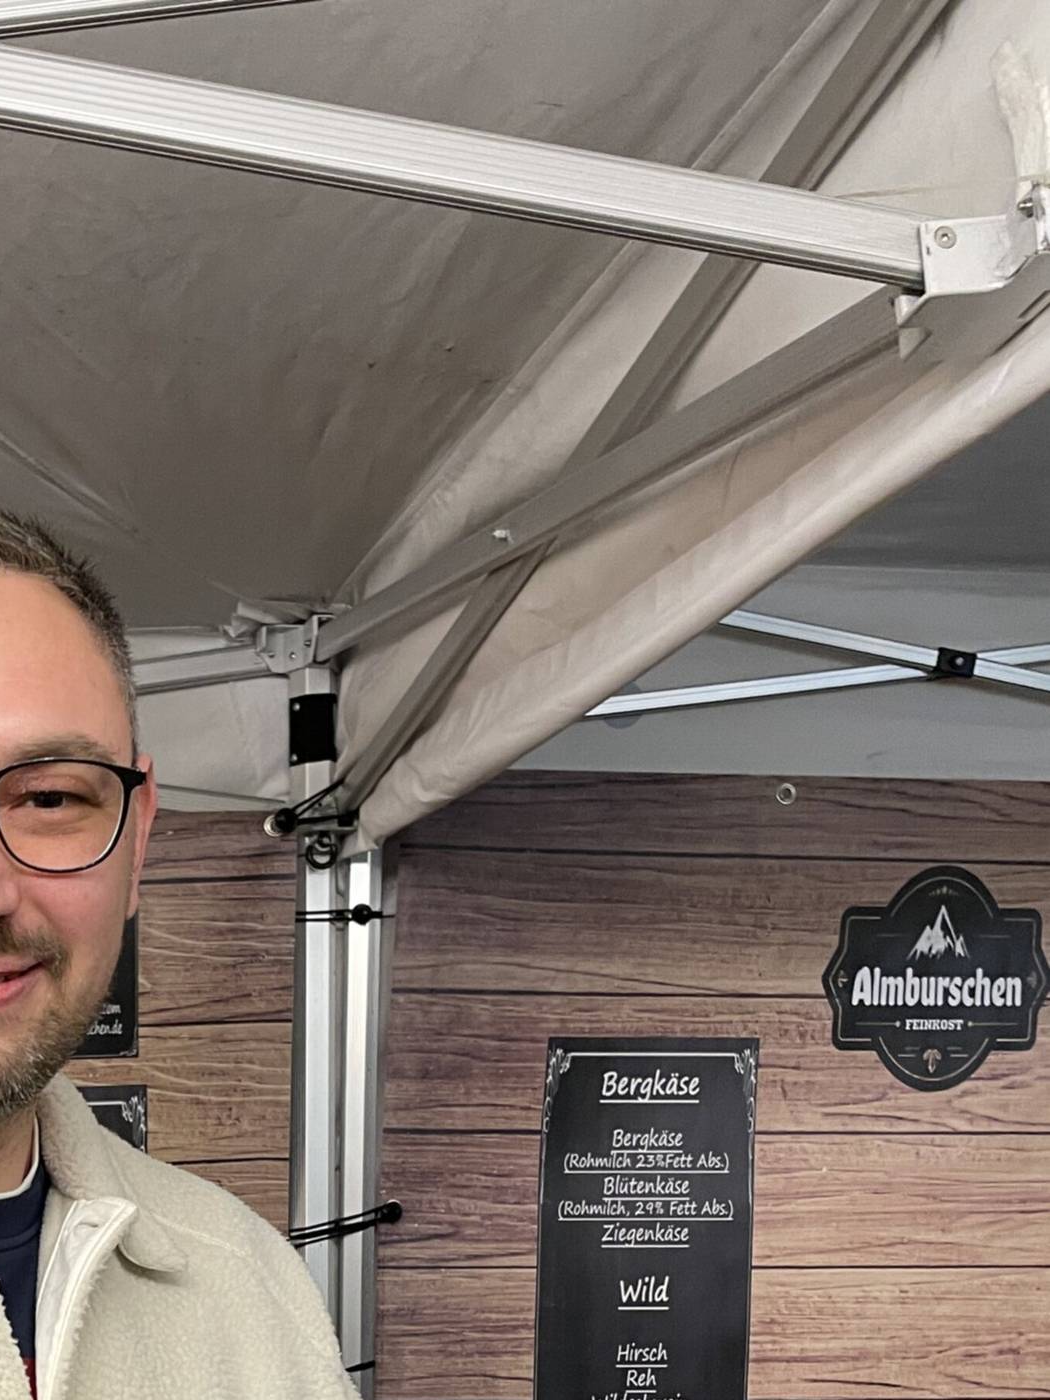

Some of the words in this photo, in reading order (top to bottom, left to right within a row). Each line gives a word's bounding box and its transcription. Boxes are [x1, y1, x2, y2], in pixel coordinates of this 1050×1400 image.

[851, 966, 1022, 1007] Almburschen
[905, 1019, 964, 1031] FEINKOST
[602, 1070, 700, 1101] Bergkäse
[612, 1128, 683, 1151] Bergkäse
[564, 1153, 631, 1172] (Rohmilch
[697, 1152, 729, 1171] Abs.)
[603, 1176, 690, 1196] Blütenkäse
[558, 1200, 630, 1219] (Rohmilch,
[635, 1202, 664, 1216] 29%
[669, 1201, 698, 1215] Fett
[701, 1200, 734, 1219] Abs.)
[601, 1223, 690, 1245] Ziegenkäse
[620, 1275, 670, 1303] Wild
[617, 1342, 668, 1363] Hirsch
[626, 1368, 657, 1387] Reh
